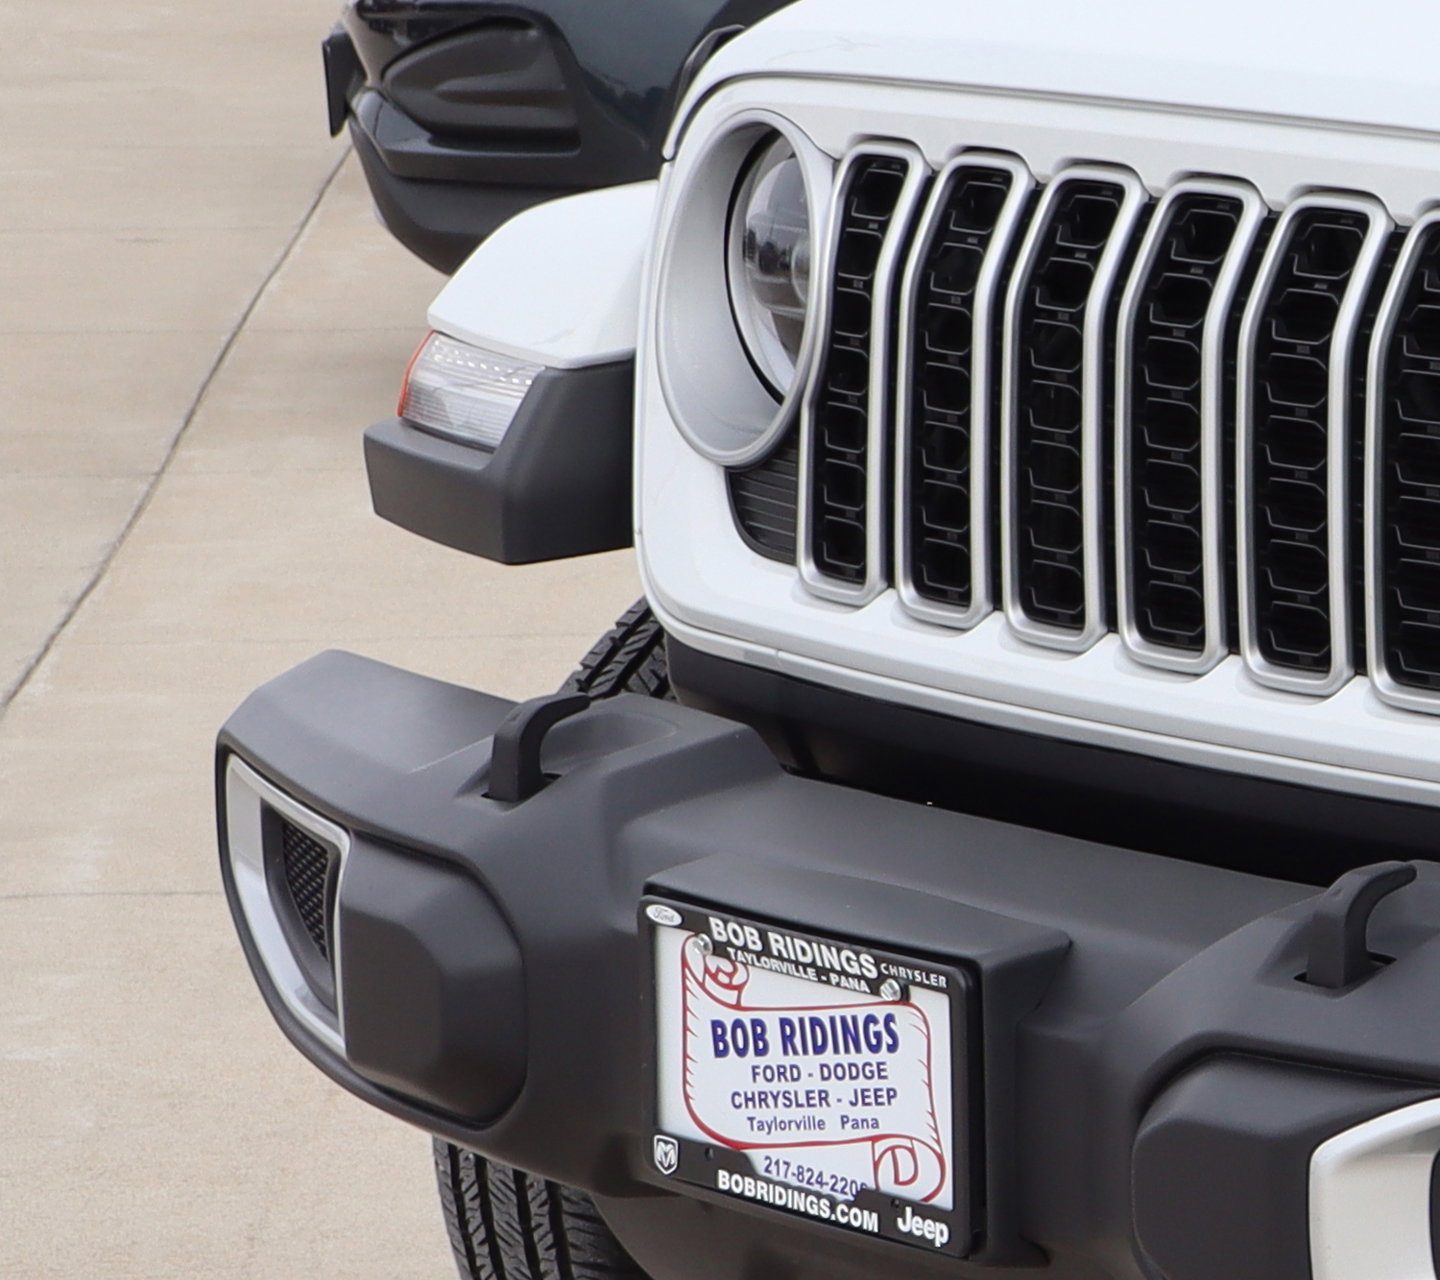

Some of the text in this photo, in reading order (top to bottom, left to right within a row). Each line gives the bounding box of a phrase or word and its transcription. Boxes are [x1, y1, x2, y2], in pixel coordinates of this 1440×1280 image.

[708, 916, 879, 980] BOB RIDINGS
[727, 947, 817, 982] TAYLORVILLE
[829, 973, 871, 995] PANA
[880, 962, 947, 989] CHRYSLER
[710, 1012, 900, 1059] BOB RIDINGS
[751, 1064, 801, 1083] FORD
[819, 1061, 889, 1081] DODGE
[730, 1088, 830, 1110] CHRYSLER
[848, 1087, 898, 1107] JEEP
[746, 1115, 880, 1135] Taylorville Pana
[717, 1170, 879, 1233] BOBRIDINGS.COM
[897, 1207, 949, 1248] Jeep
